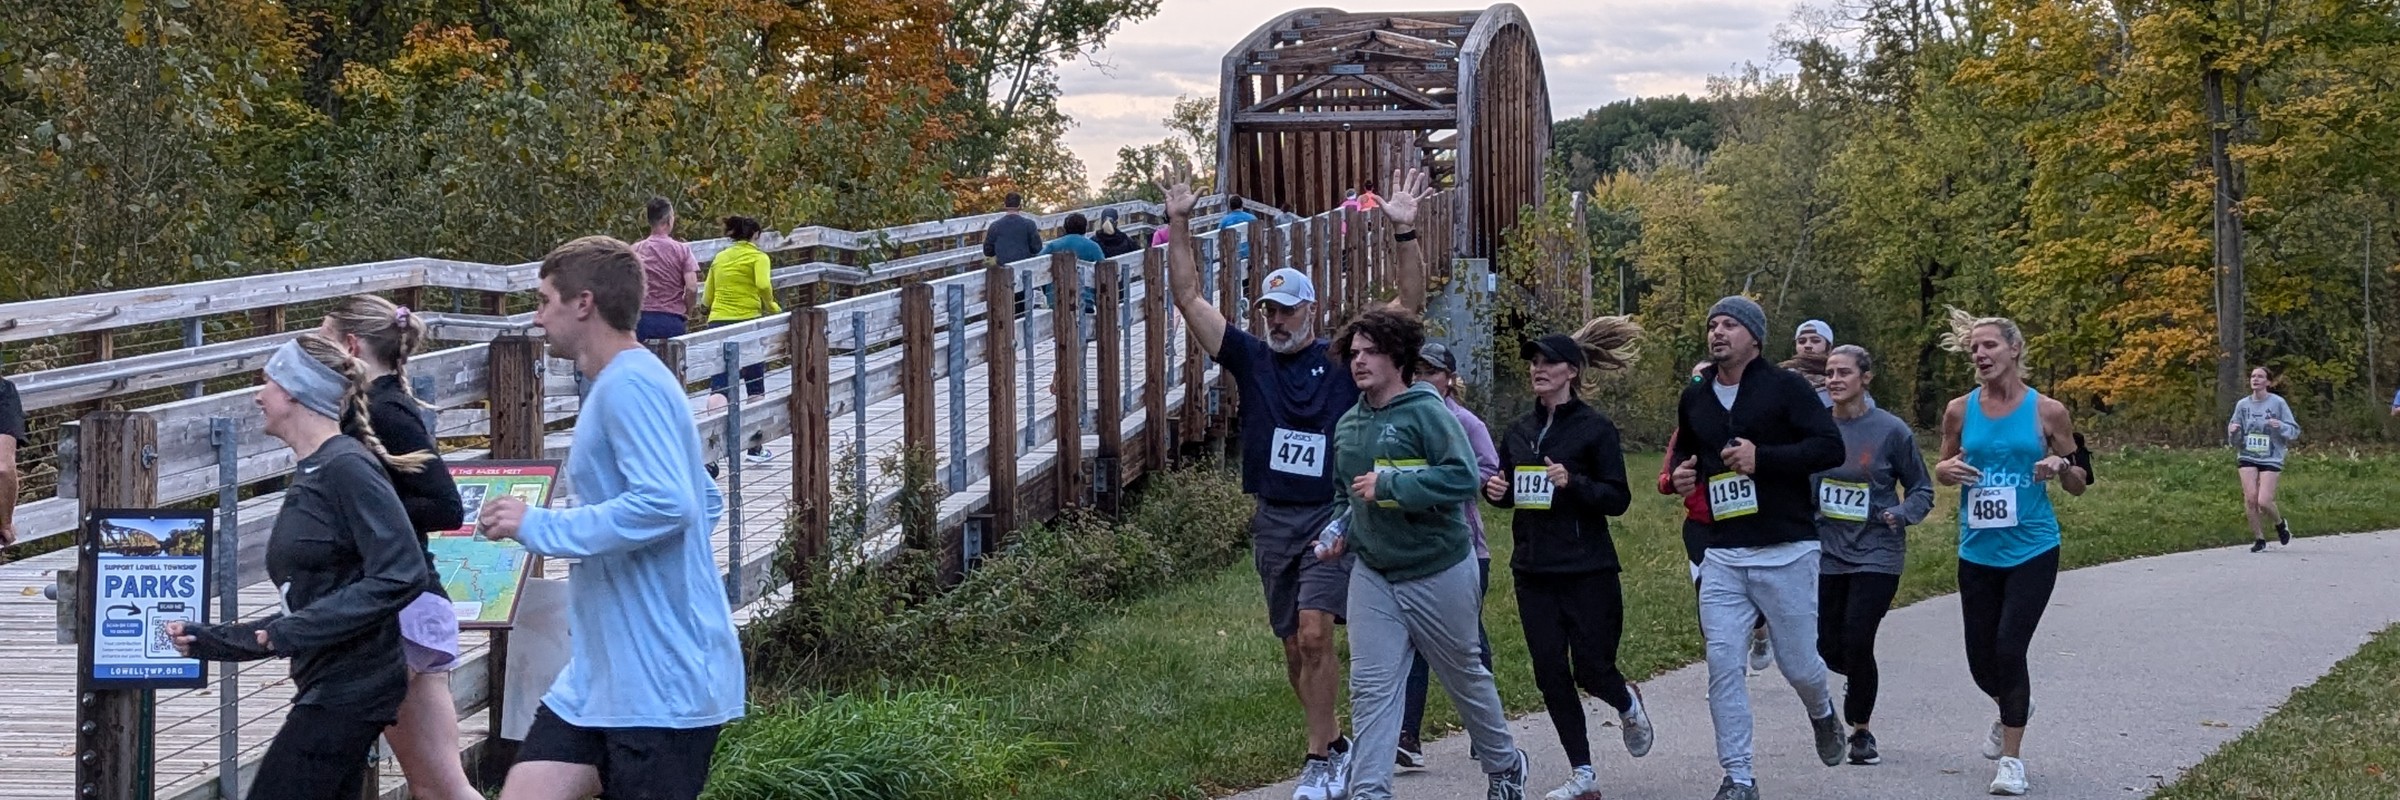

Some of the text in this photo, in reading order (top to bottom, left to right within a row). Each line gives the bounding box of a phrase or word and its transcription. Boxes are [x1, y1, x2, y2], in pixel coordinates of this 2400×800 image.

[1278, 442, 1315, 467] 474
[1517, 474, 1549, 493] 1191
[1975, 466, 2031, 488] didas
[1712, 479, 1751, 505] 1195
[1823, 486, 1866, 507] 1172
[1973, 499, 2008, 520] 488
[104, 575, 195, 599] PARKS
[110, 667, 183, 676] LOWELLTWP.ORG
